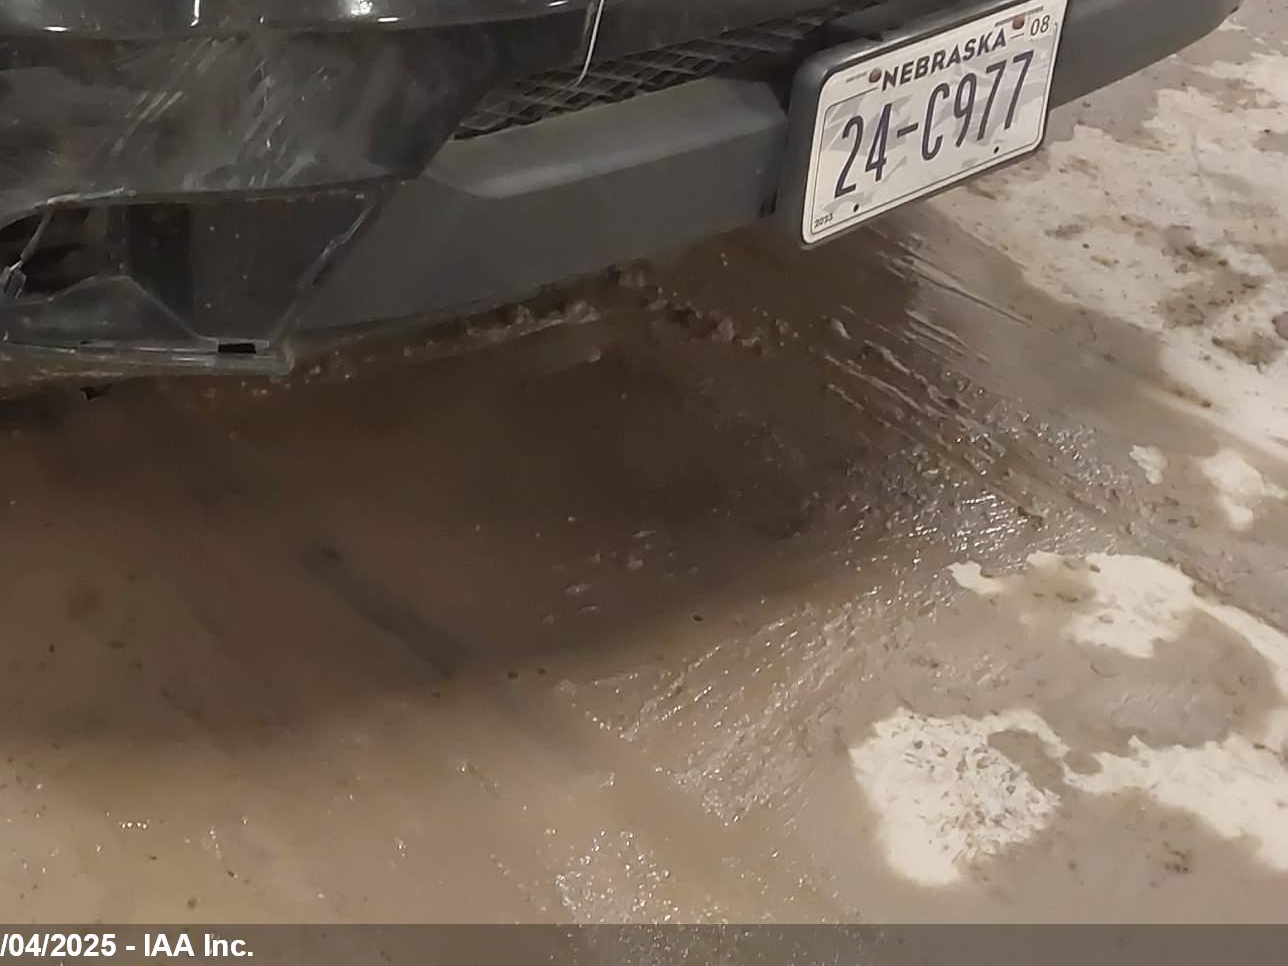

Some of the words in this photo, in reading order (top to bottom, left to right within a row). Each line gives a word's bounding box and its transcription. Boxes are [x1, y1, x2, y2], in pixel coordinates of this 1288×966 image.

[1030, 15, 1050, 37] 08
[882, 30, 1006, 91] NEBRASKA
[834, 51, 1034, 198] 24-C977
